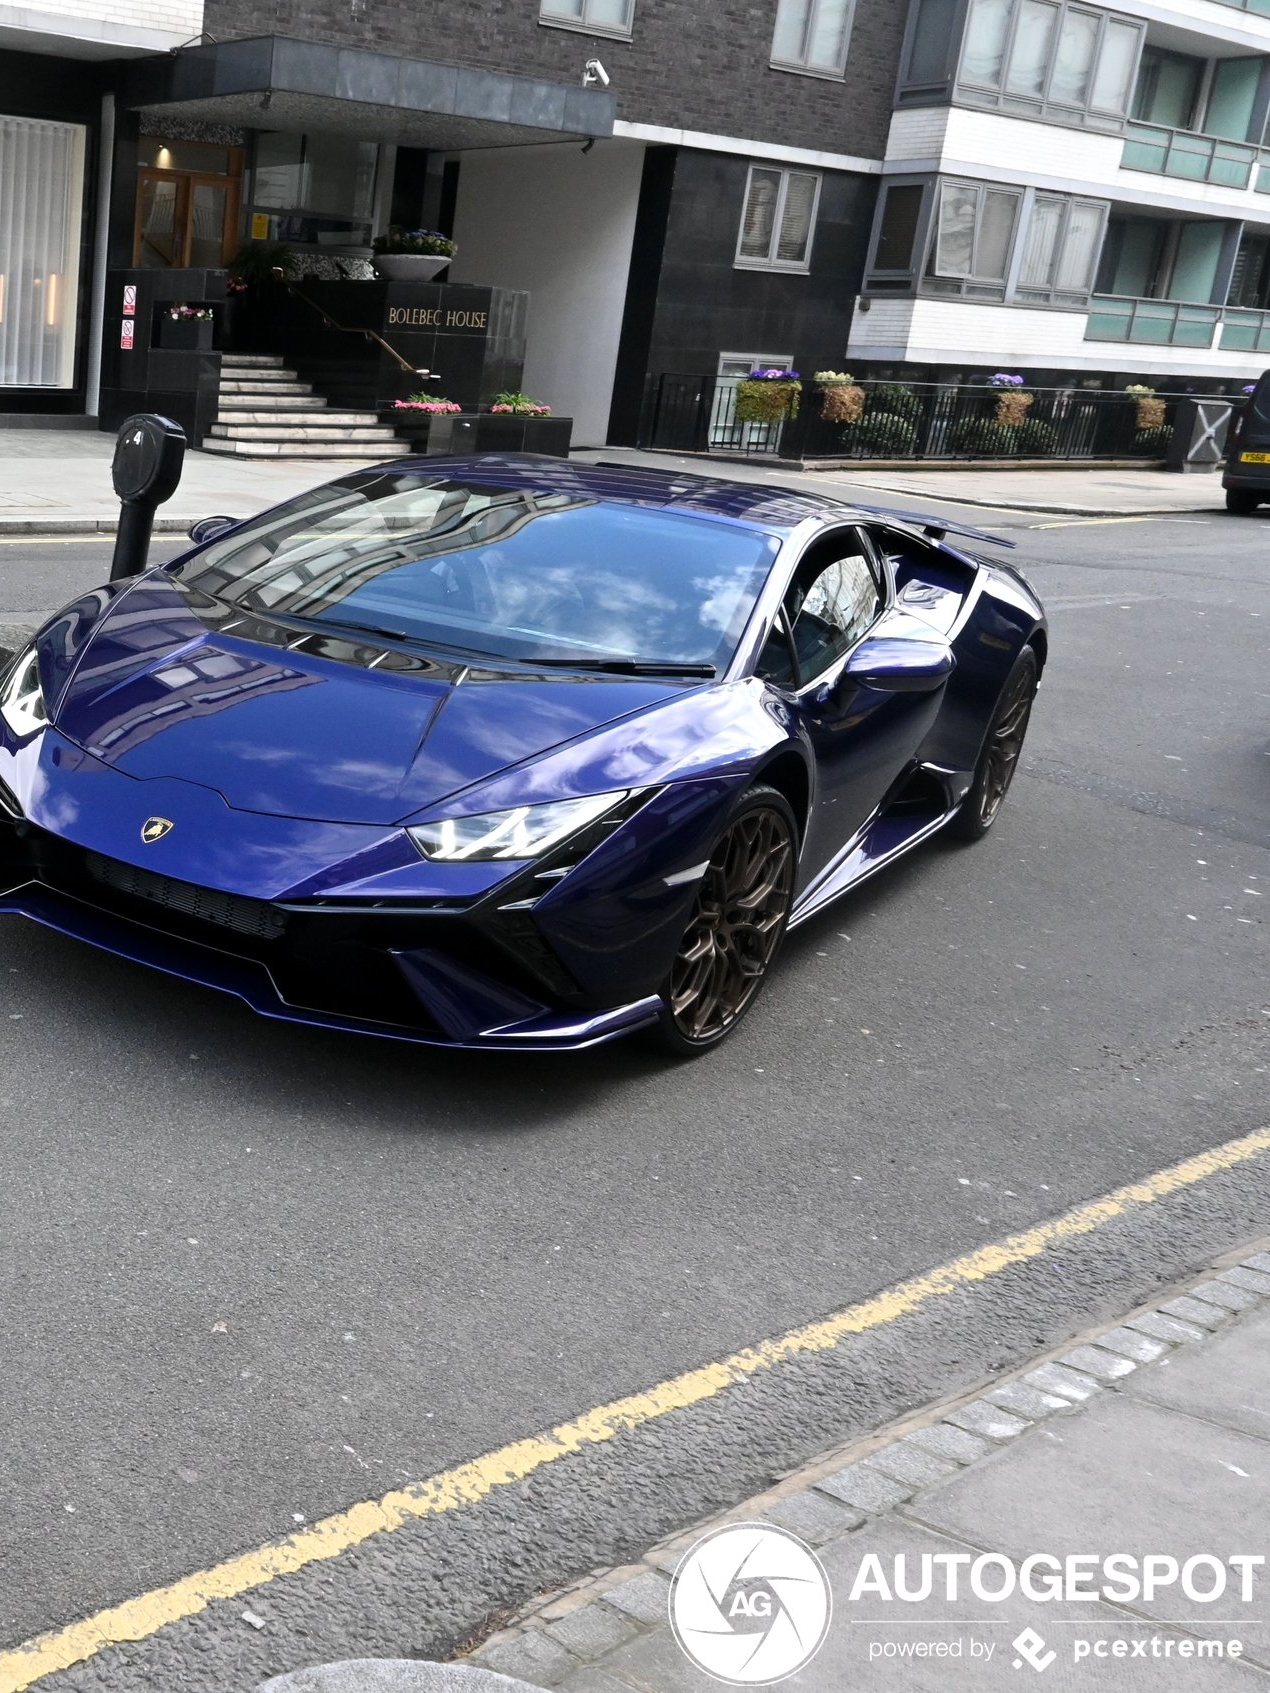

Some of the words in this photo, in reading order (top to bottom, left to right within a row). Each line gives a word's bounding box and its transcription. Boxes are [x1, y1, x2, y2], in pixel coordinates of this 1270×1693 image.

[389, 307, 443, 326] BOLEBEC
[446, 310, 488, 328] HOUSE
[133, 430, 141, 445] 4
